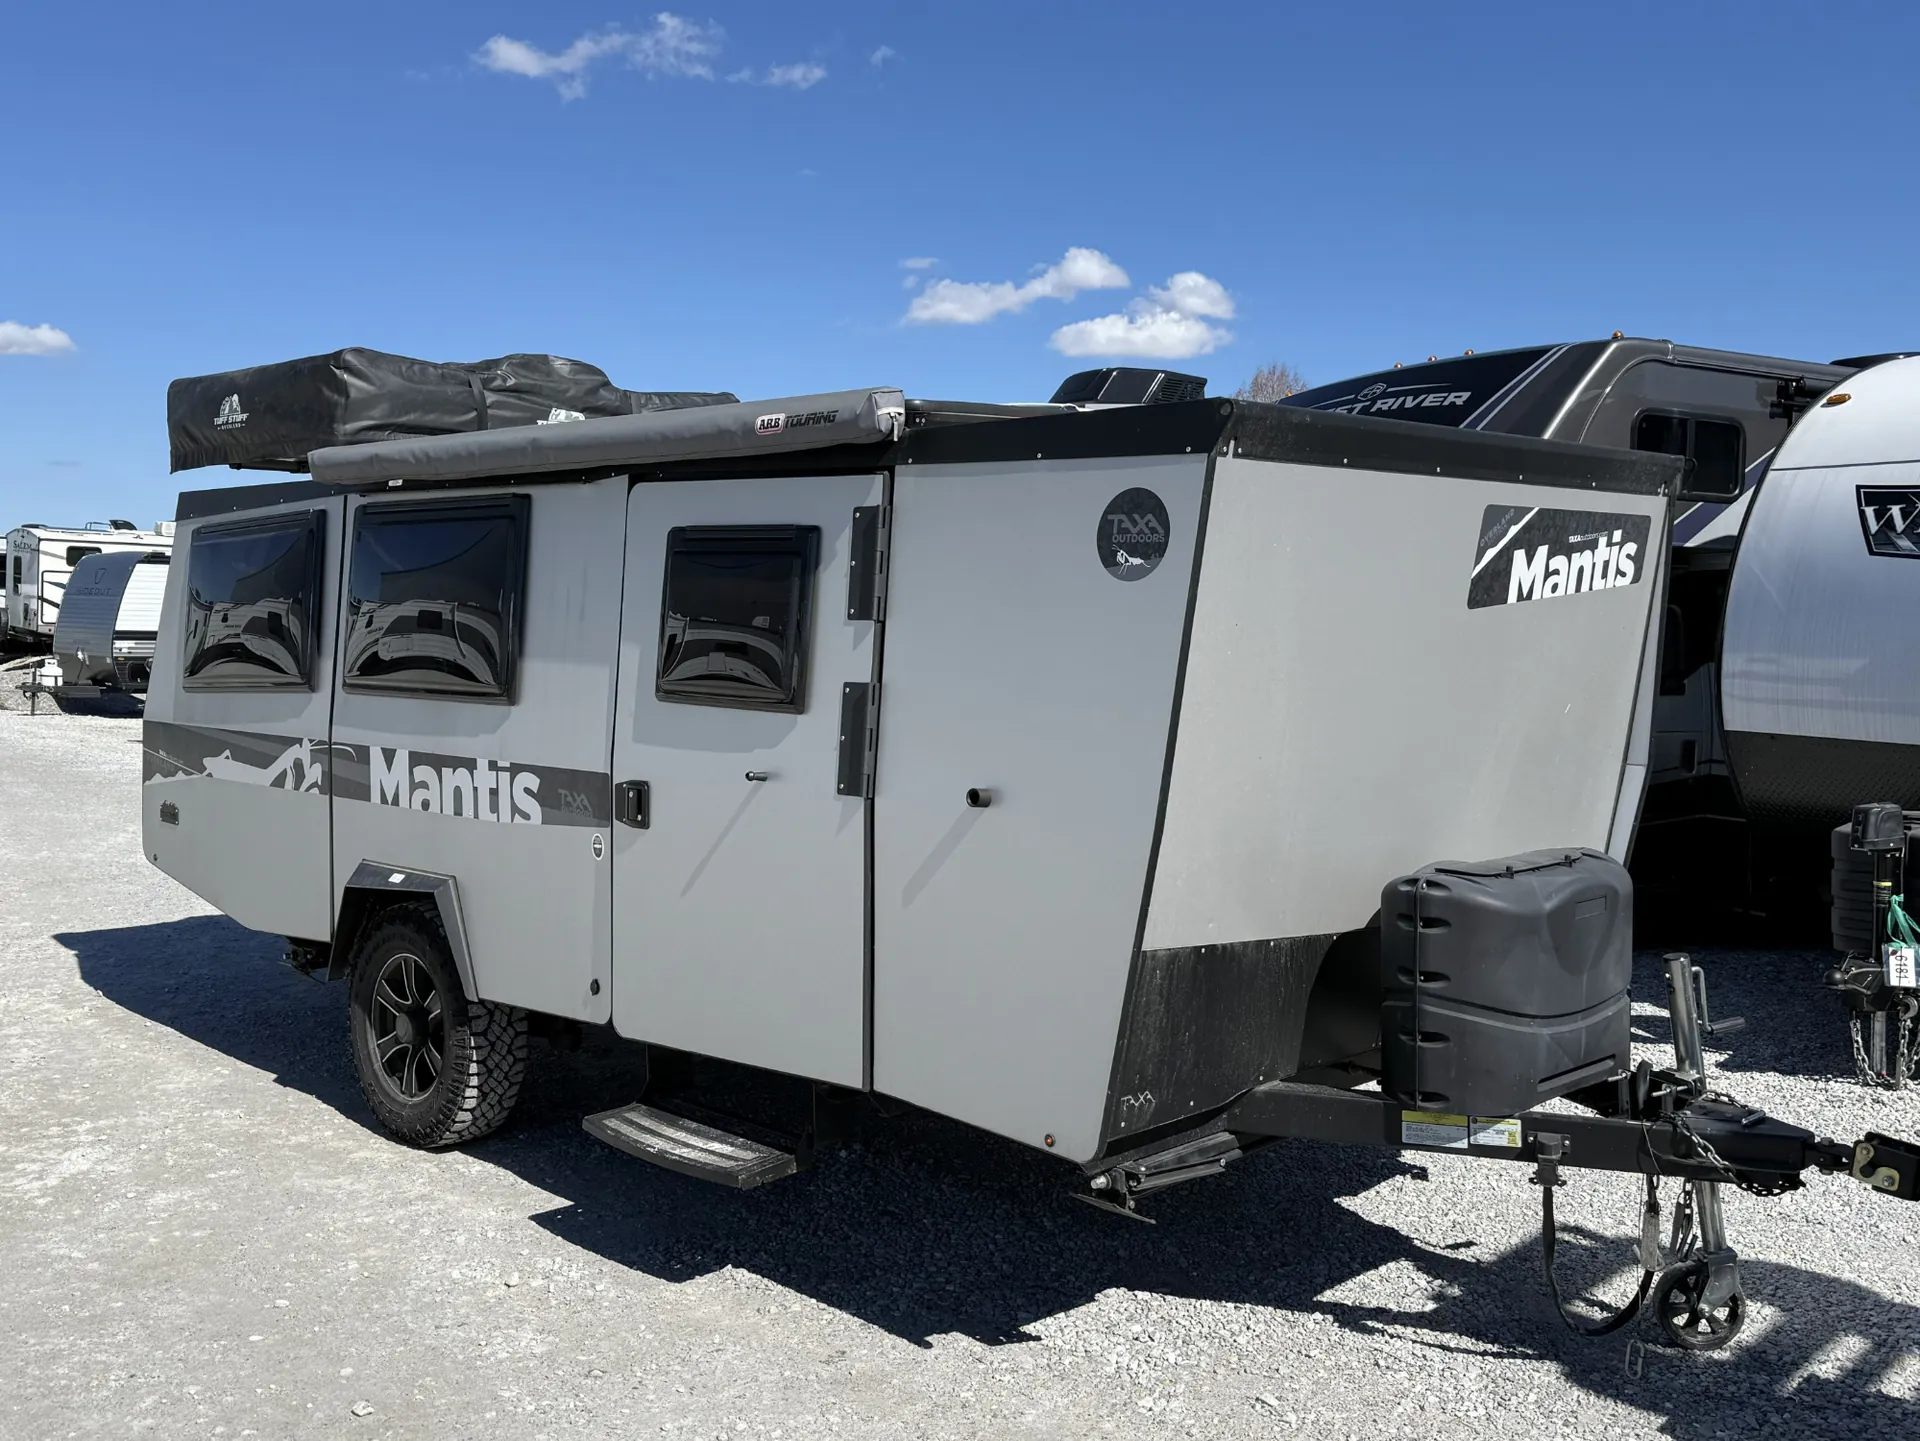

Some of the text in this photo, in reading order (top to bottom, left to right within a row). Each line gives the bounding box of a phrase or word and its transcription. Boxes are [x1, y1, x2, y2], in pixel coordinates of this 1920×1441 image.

[1369, 391, 1472, 413] RIVER
[213, 413, 249, 425] TUFF STUFF
[758, 409, 839, 431] ARB TOURING
[1107, 513, 1165, 534] TAXA
[1479, 508, 1515, 547] OVERLAND
[1112, 534, 1165, 543] OUTDOORS
[1506, 529, 1638, 604] Mantis
[76, 587, 111, 596] HIDEOUT
[369, 746, 542, 825] Mantis
[557, 788, 592, 812] TAXA
[1895, 955, 1908, 979] 6181
[1121, 1090, 1156, 1111] TAXA
